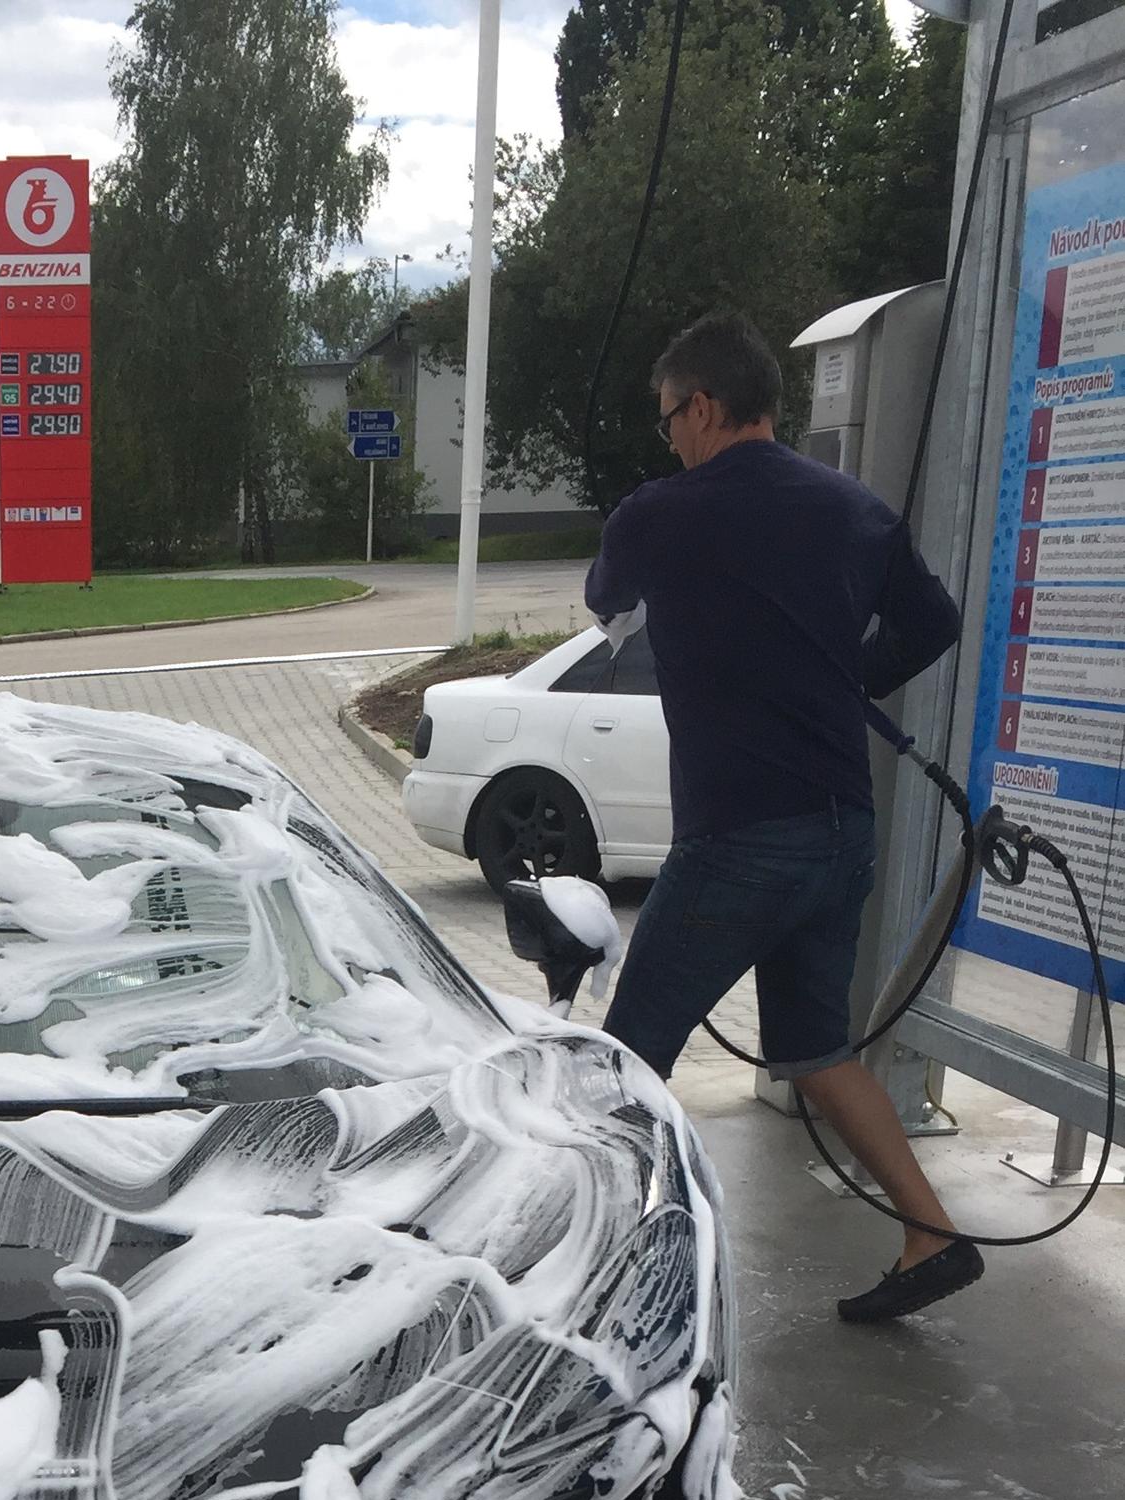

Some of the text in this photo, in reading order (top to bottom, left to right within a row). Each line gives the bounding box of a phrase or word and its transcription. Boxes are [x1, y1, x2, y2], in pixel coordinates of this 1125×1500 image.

[1050, 219, 1091, 257] Návod
[1093, 219, 1100, 245] k
[30, 353, 80, 374] 27.90
[1035, 368, 1114, 401] Popis programů:
[4, 394, 17, 404] 95
[30, 384, 81, 405] 29.40
[31, 414, 81, 436] 29.90
[1038, 426, 1044, 445] 1
[1030, 487, 1038, 505] 2
[1024, 546, 1031, 565] 3
[1018, 601, 1025, 620] 4
[1011, 660, 1018, 677] 5
[1005, 717, 1012, 735] 6
